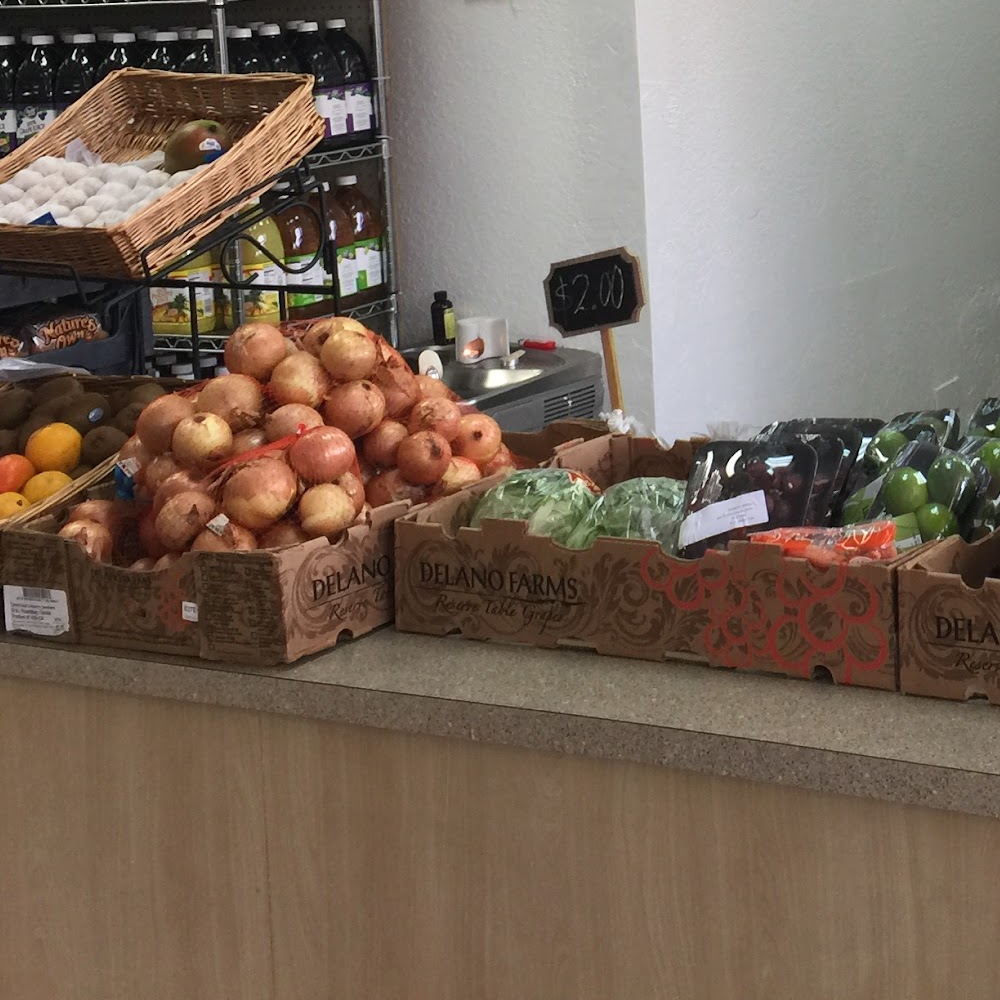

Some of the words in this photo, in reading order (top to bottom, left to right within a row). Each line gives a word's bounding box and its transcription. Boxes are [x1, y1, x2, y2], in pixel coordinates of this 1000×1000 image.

[555, 264, 624, 314] $2.00
[312, 555, 391, 601] DELANO
[420, 561, 504, 592] DELANO
[509, 571, 578, 600] FARMS
